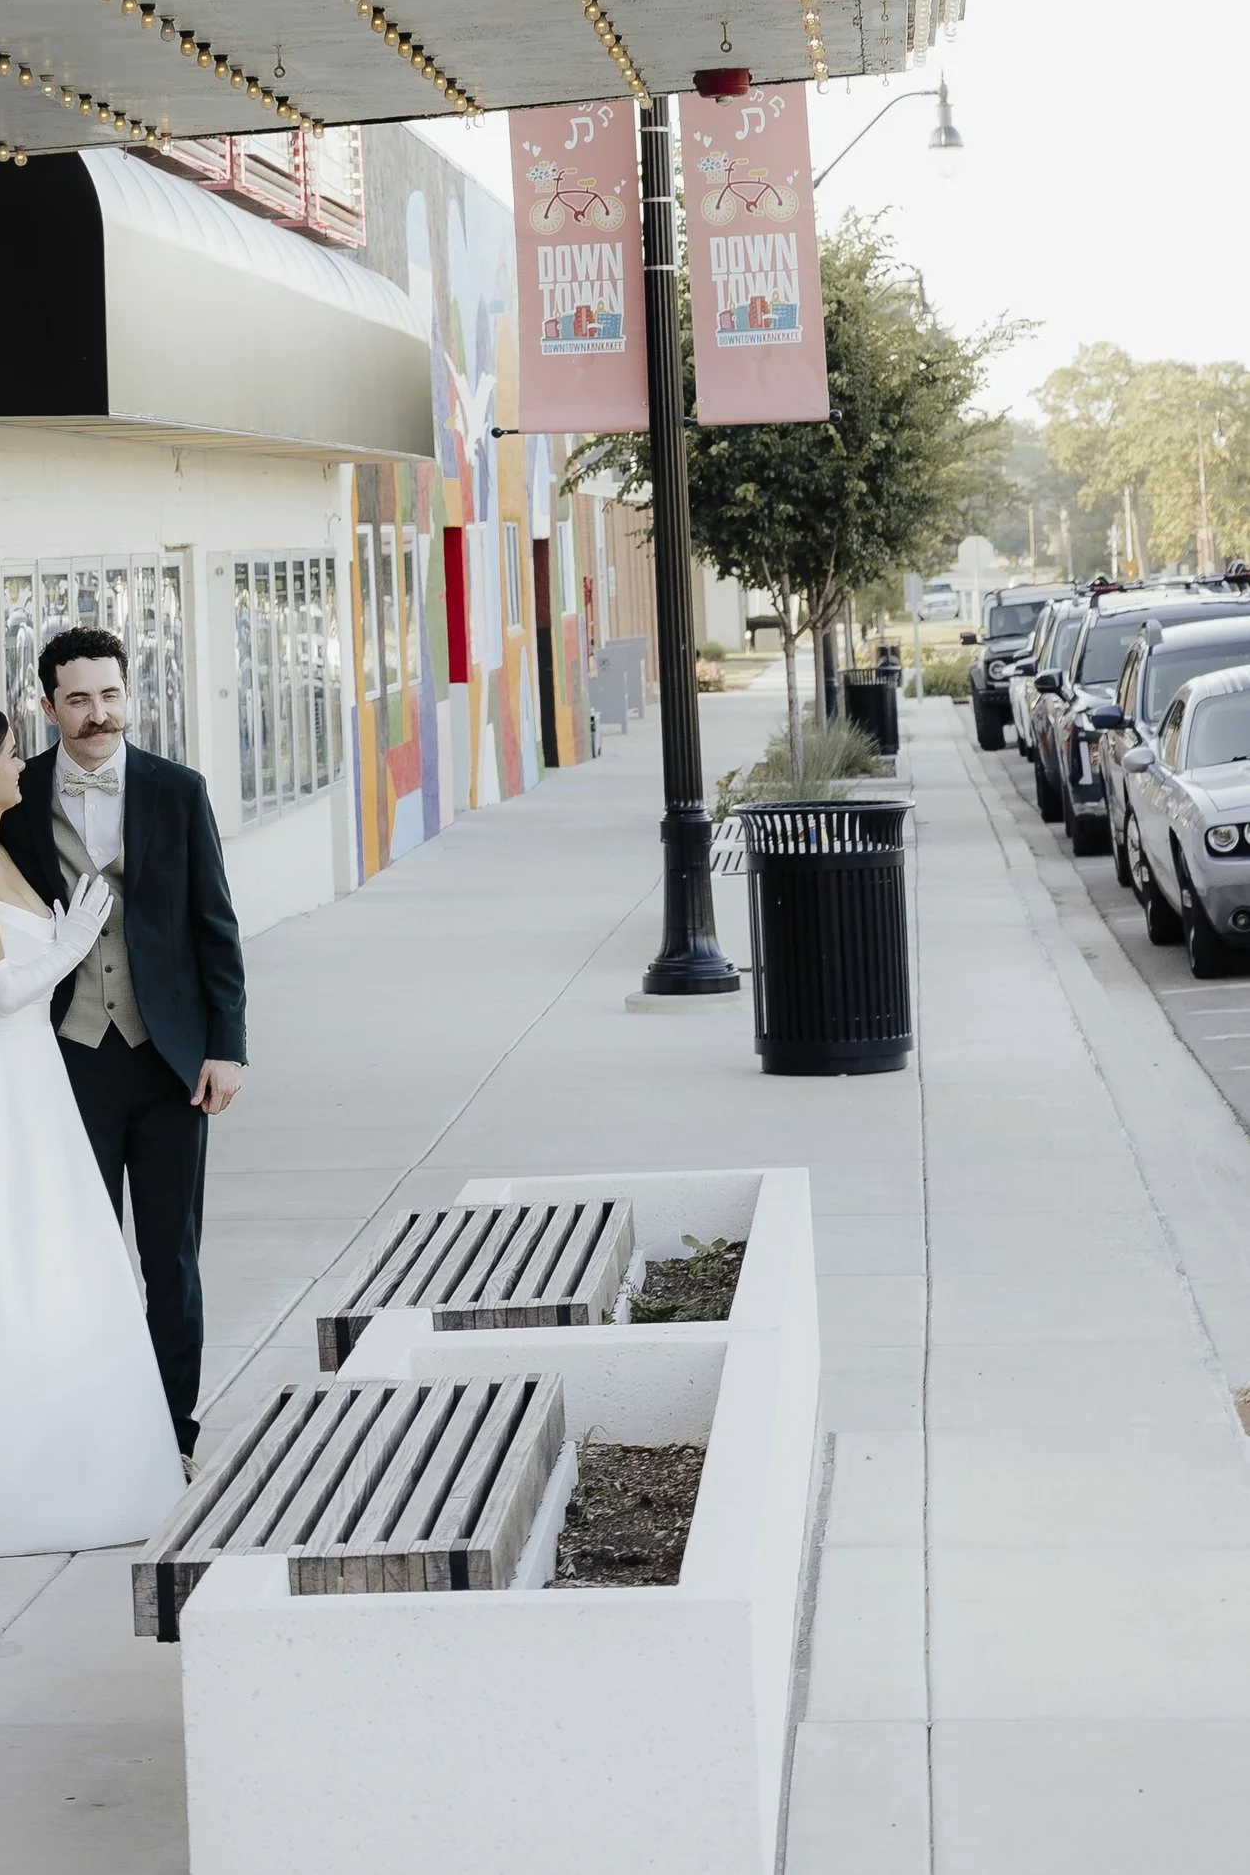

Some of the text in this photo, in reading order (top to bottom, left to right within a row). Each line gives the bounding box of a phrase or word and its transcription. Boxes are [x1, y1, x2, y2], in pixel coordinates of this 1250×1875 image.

[537, 242, 623, 283] DOWN
[710, 232, 798, 274] DOWN
[539, 279, 624, 320] TOWN
[712, 270, 800, 313] TOWN
